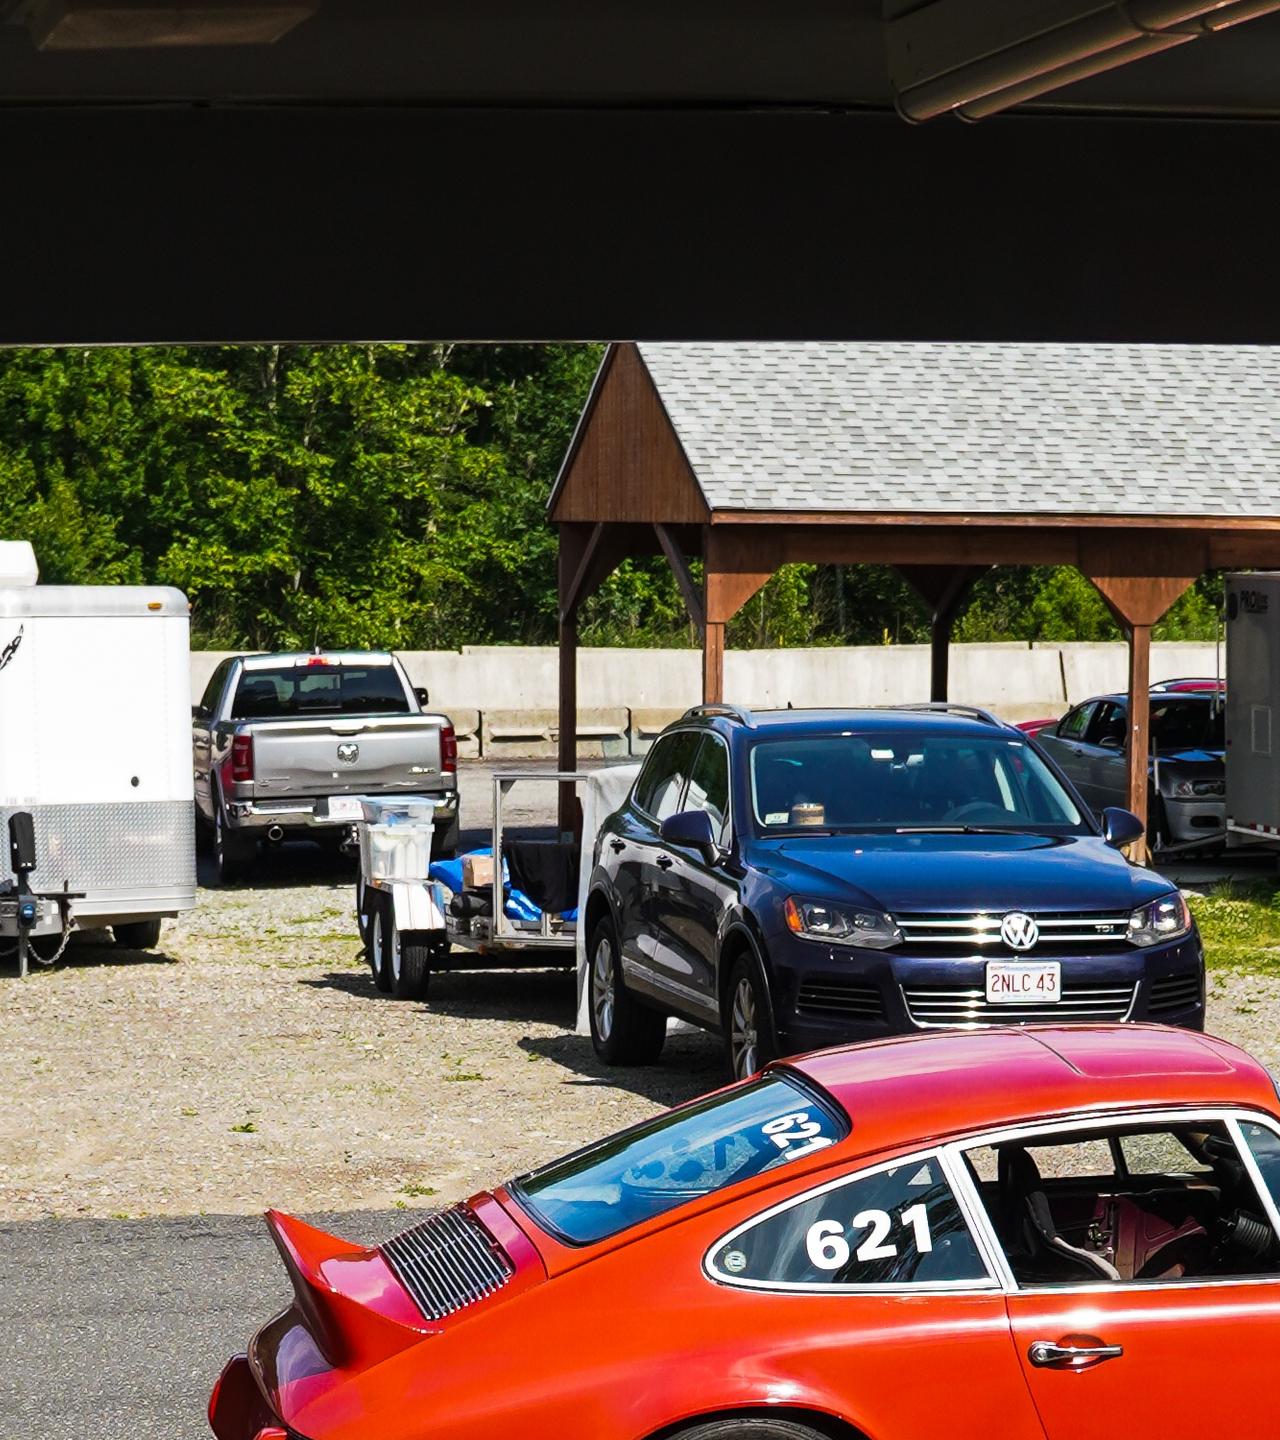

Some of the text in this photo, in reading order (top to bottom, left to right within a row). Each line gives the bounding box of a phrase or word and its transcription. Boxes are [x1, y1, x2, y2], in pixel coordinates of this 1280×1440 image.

[1095, 924, 1114, 933] TDI
[991, 973, 1056, 993] 2NLC 43
[762, 1113, 832, 1160] 621
[806, 1203, 933, 1270] 621
